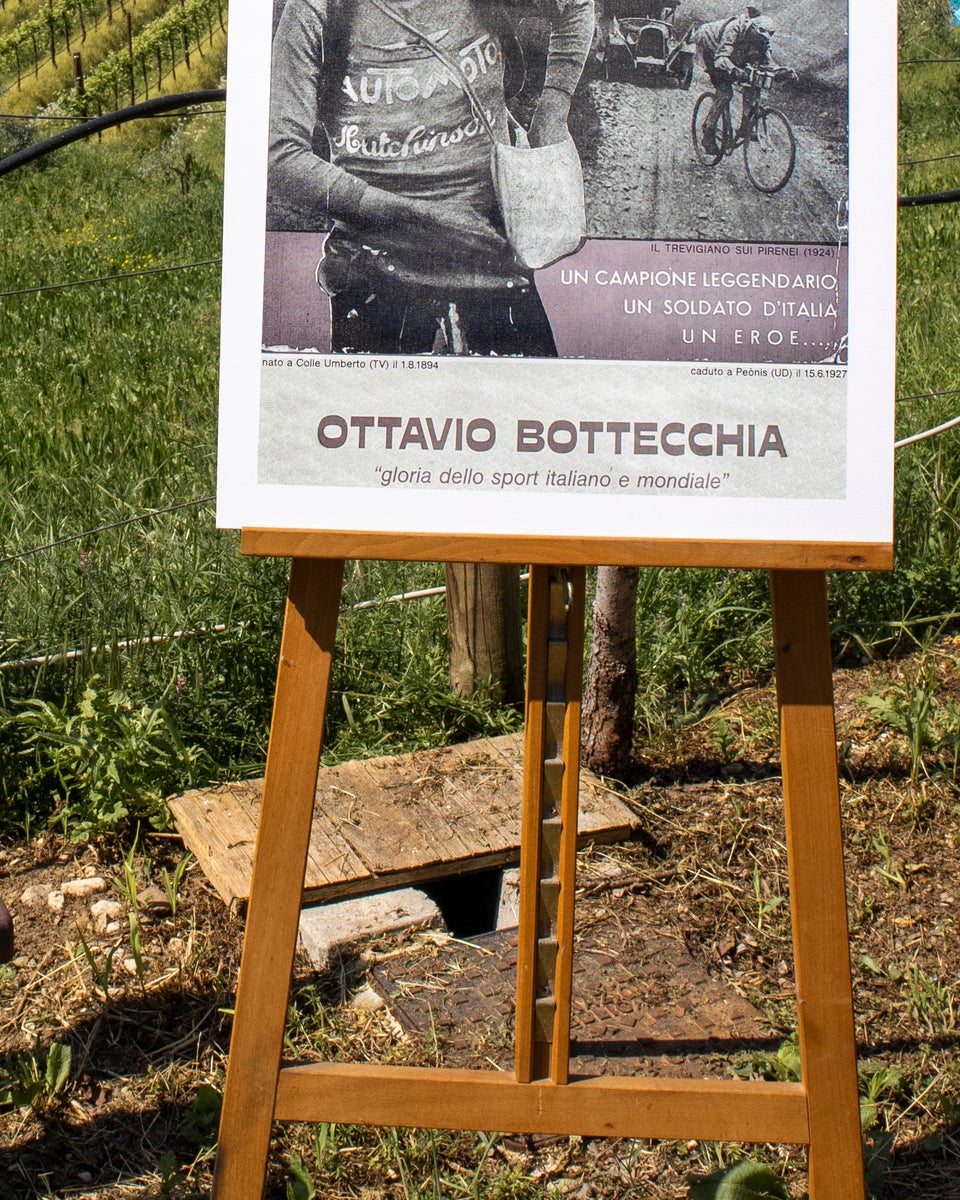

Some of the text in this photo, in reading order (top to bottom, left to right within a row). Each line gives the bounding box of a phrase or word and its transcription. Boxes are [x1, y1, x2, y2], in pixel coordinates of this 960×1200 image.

[651, 243, 835, 258] IL TREVIGIANO SUI PIRENEI (1924)
[560, 269, 837, 290] UN CAMPIONE LEGGENDARIO
[624, 299, 837, 318] UN SOLDATO D'ITALIA
[682, 329, 717, 344] UN
[262, 359, 284, 367] nato
[296, 359, 321, 368] Colle
[324, 359, 366, 369] Umberto
[369, 360, 389, 370] (TV)
[392, 360, 398, 369] il
[401, 361, 439, 370] 1.8.1894
[690, 367, 724, 377] caduto
[736, 367, 768, 378] Peònis
[771, 368, 793, 379] (UD)
[795, 369, 801, 378] il
[804, 369, 848, 379] 15.6.1927
[317, 414, 788, 457] OTTAVIO BOTTECCHIA
[439, 468, 484, 485] dello
[491, 471, 539, 489] sport
[618, 475, 630, 488] e
